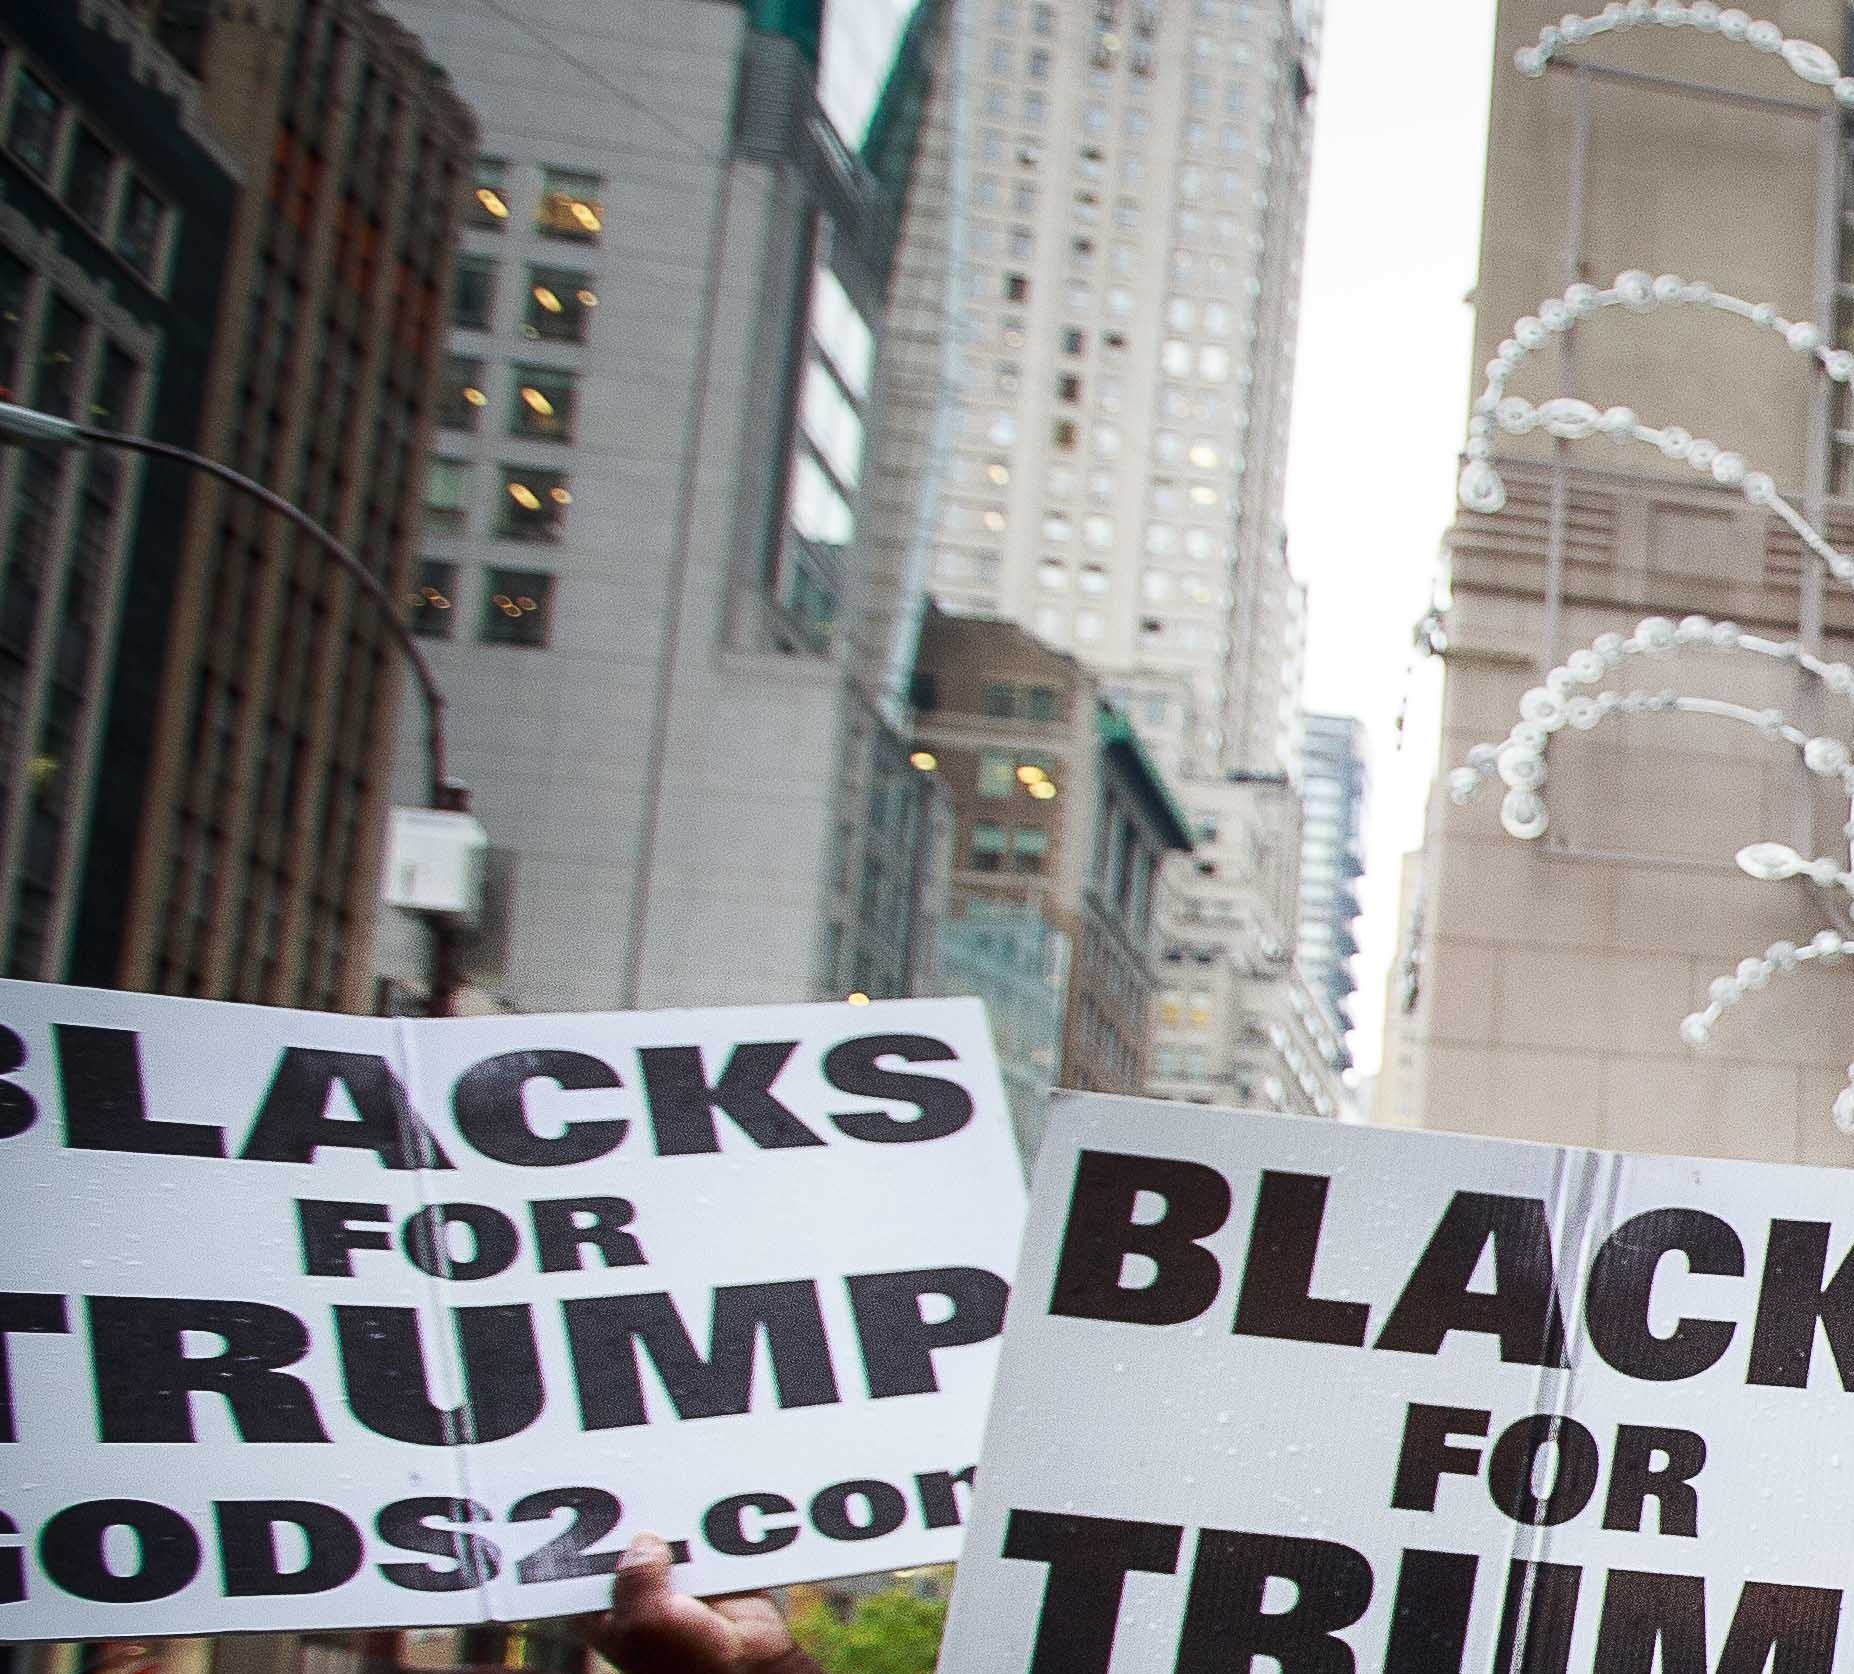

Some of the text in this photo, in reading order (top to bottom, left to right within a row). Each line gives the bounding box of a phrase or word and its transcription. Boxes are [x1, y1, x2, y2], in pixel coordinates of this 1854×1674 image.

[294, 1196, 649, 1281] FOR
[0, 1465, 977, 1604] ODS2.co
[1390, 1402, 1707, 1537] FOR
